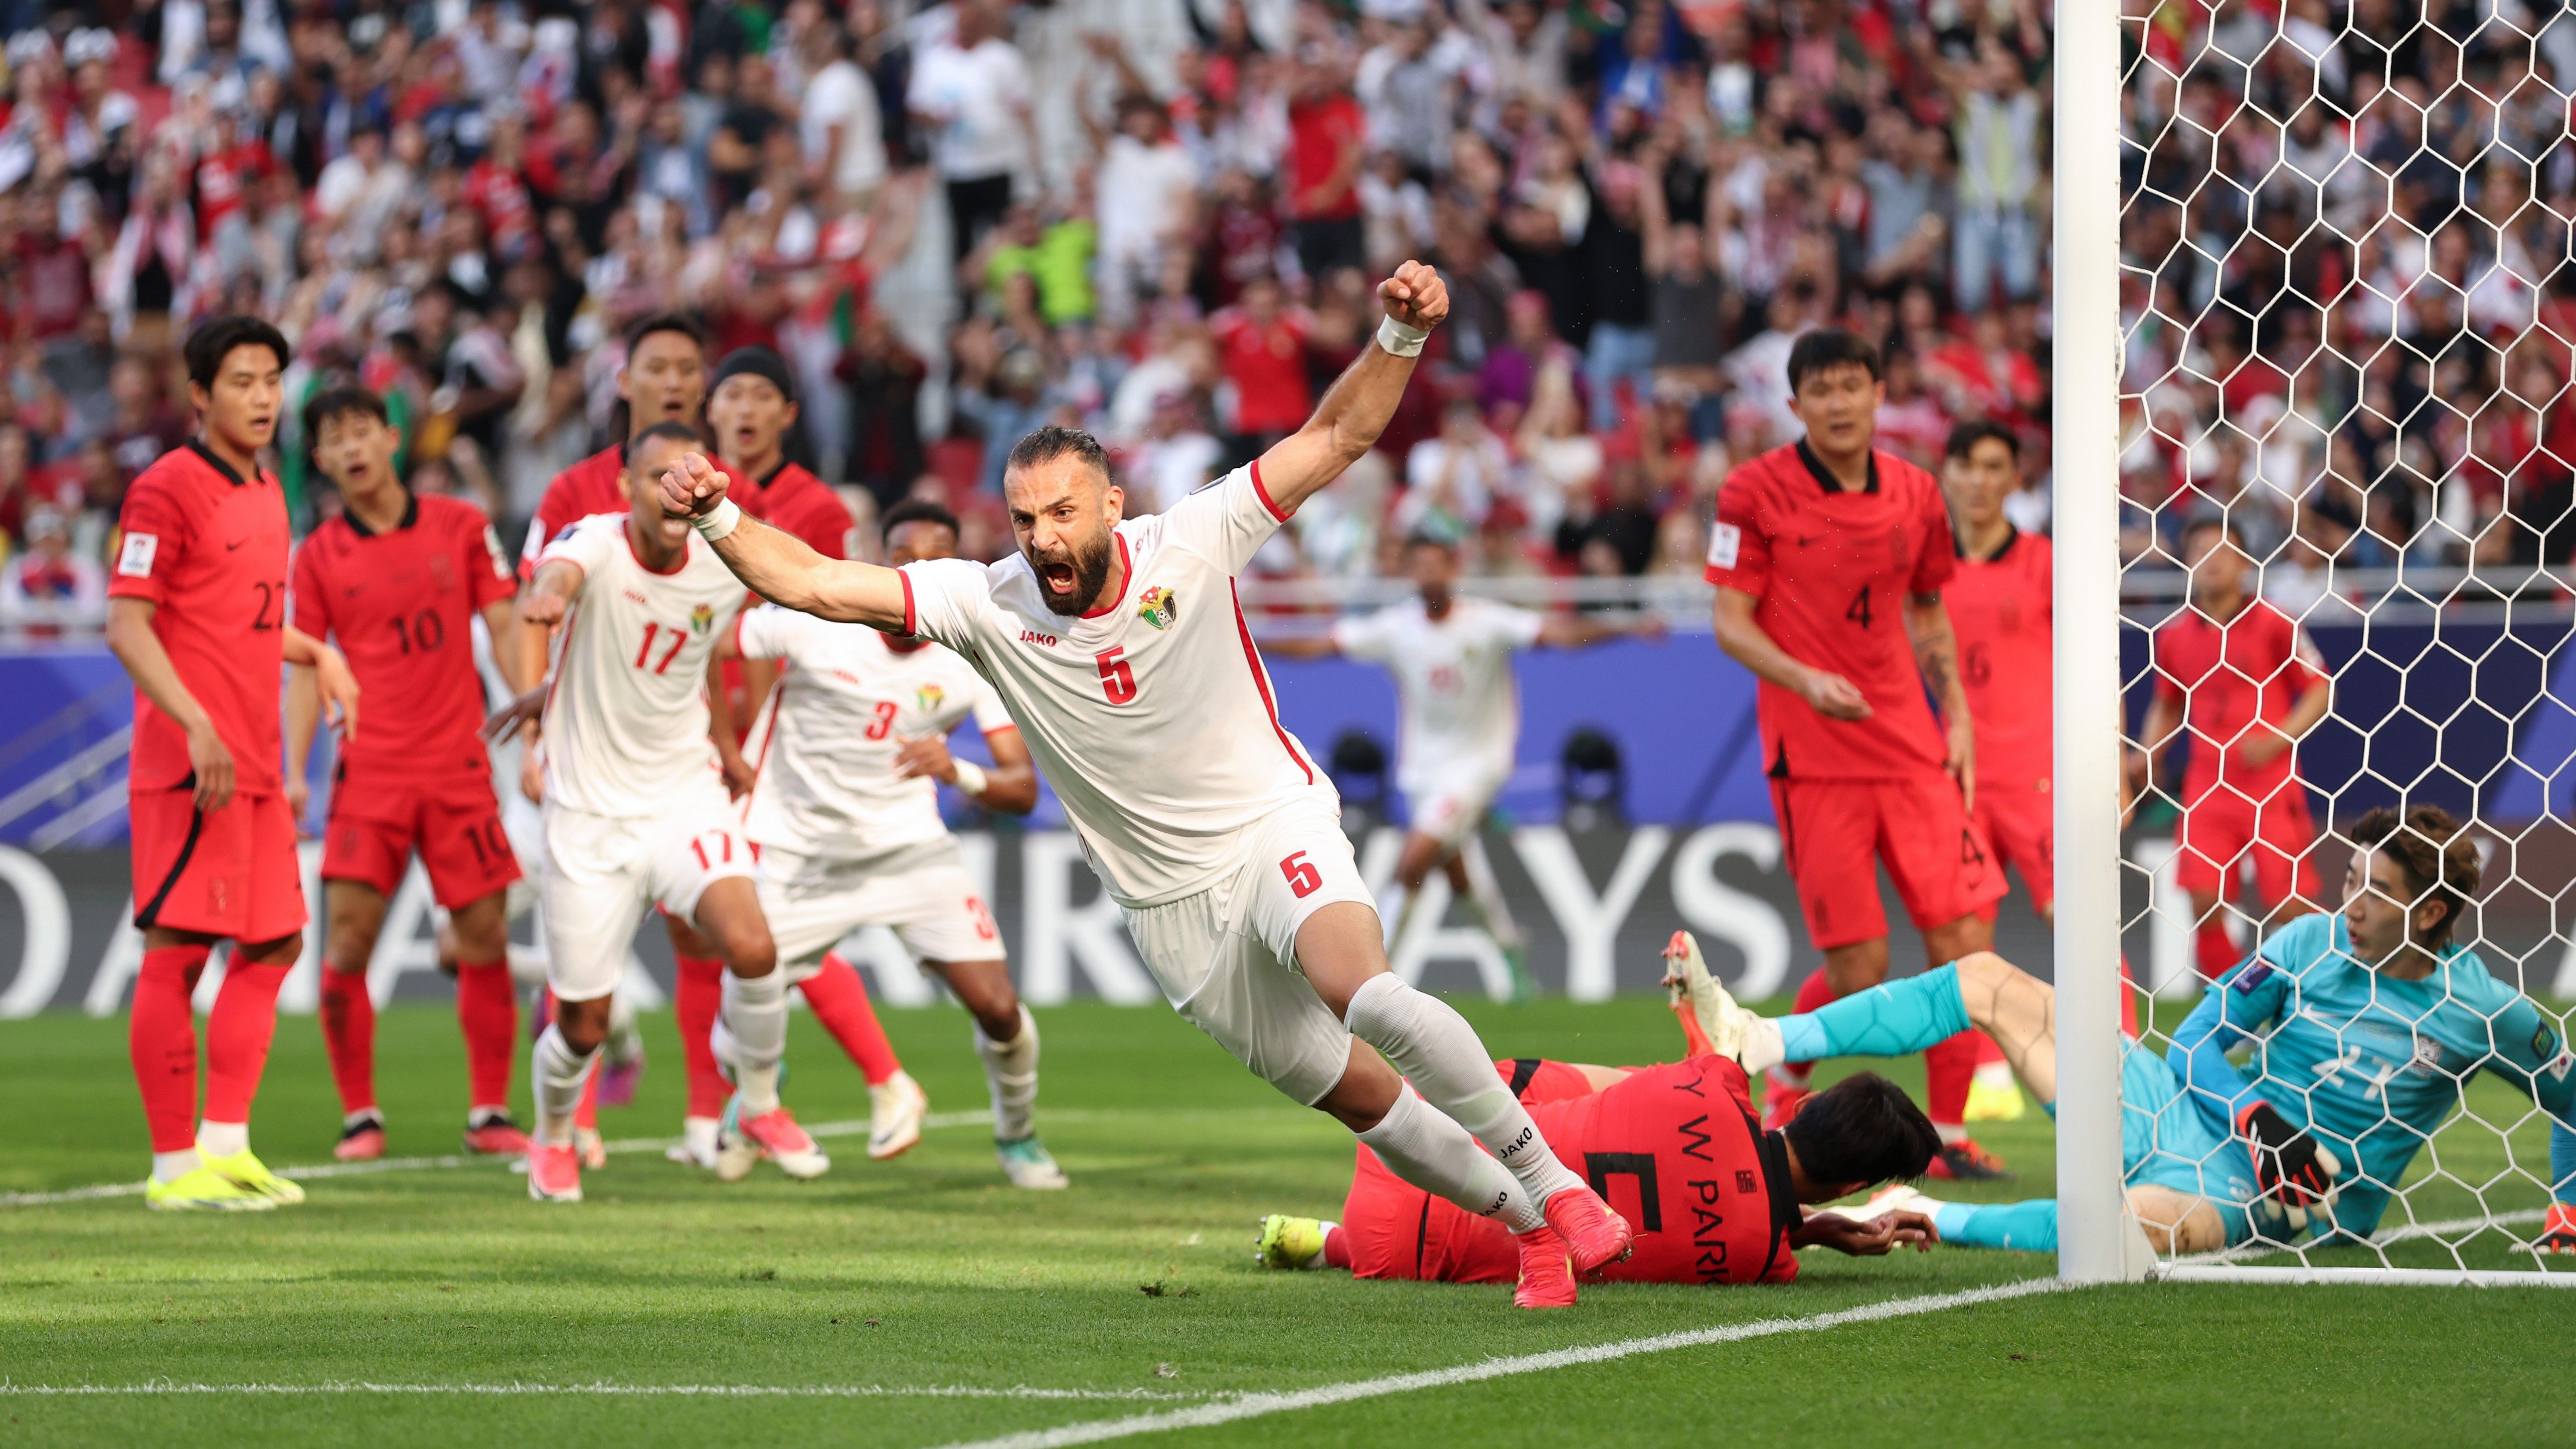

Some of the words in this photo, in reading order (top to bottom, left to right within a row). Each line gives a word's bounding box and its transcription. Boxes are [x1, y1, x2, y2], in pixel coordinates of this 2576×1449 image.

[1847, 586, 1872, 628] 4
[387, 608, 444, 654] 10
[635, 622, 688, 674] 17
[1019, 630, 1057, 647] JAKO
[1095, 645, 1137, 704] 5
[1966, 642, 1990, 686] 6
[865, 701, 897, 740] 3
[691, 828, 731, 871] 17
[1962, 829, 1984, 866] 4
[1279, 850, 1322, 898] 5
[966, 897, 994, 939] 3
[1673, 1076, 1705, 1098] Y
[1500, 1127, 1532, 1159] JAKO
[1678, 1114, 1713, 1162] W
